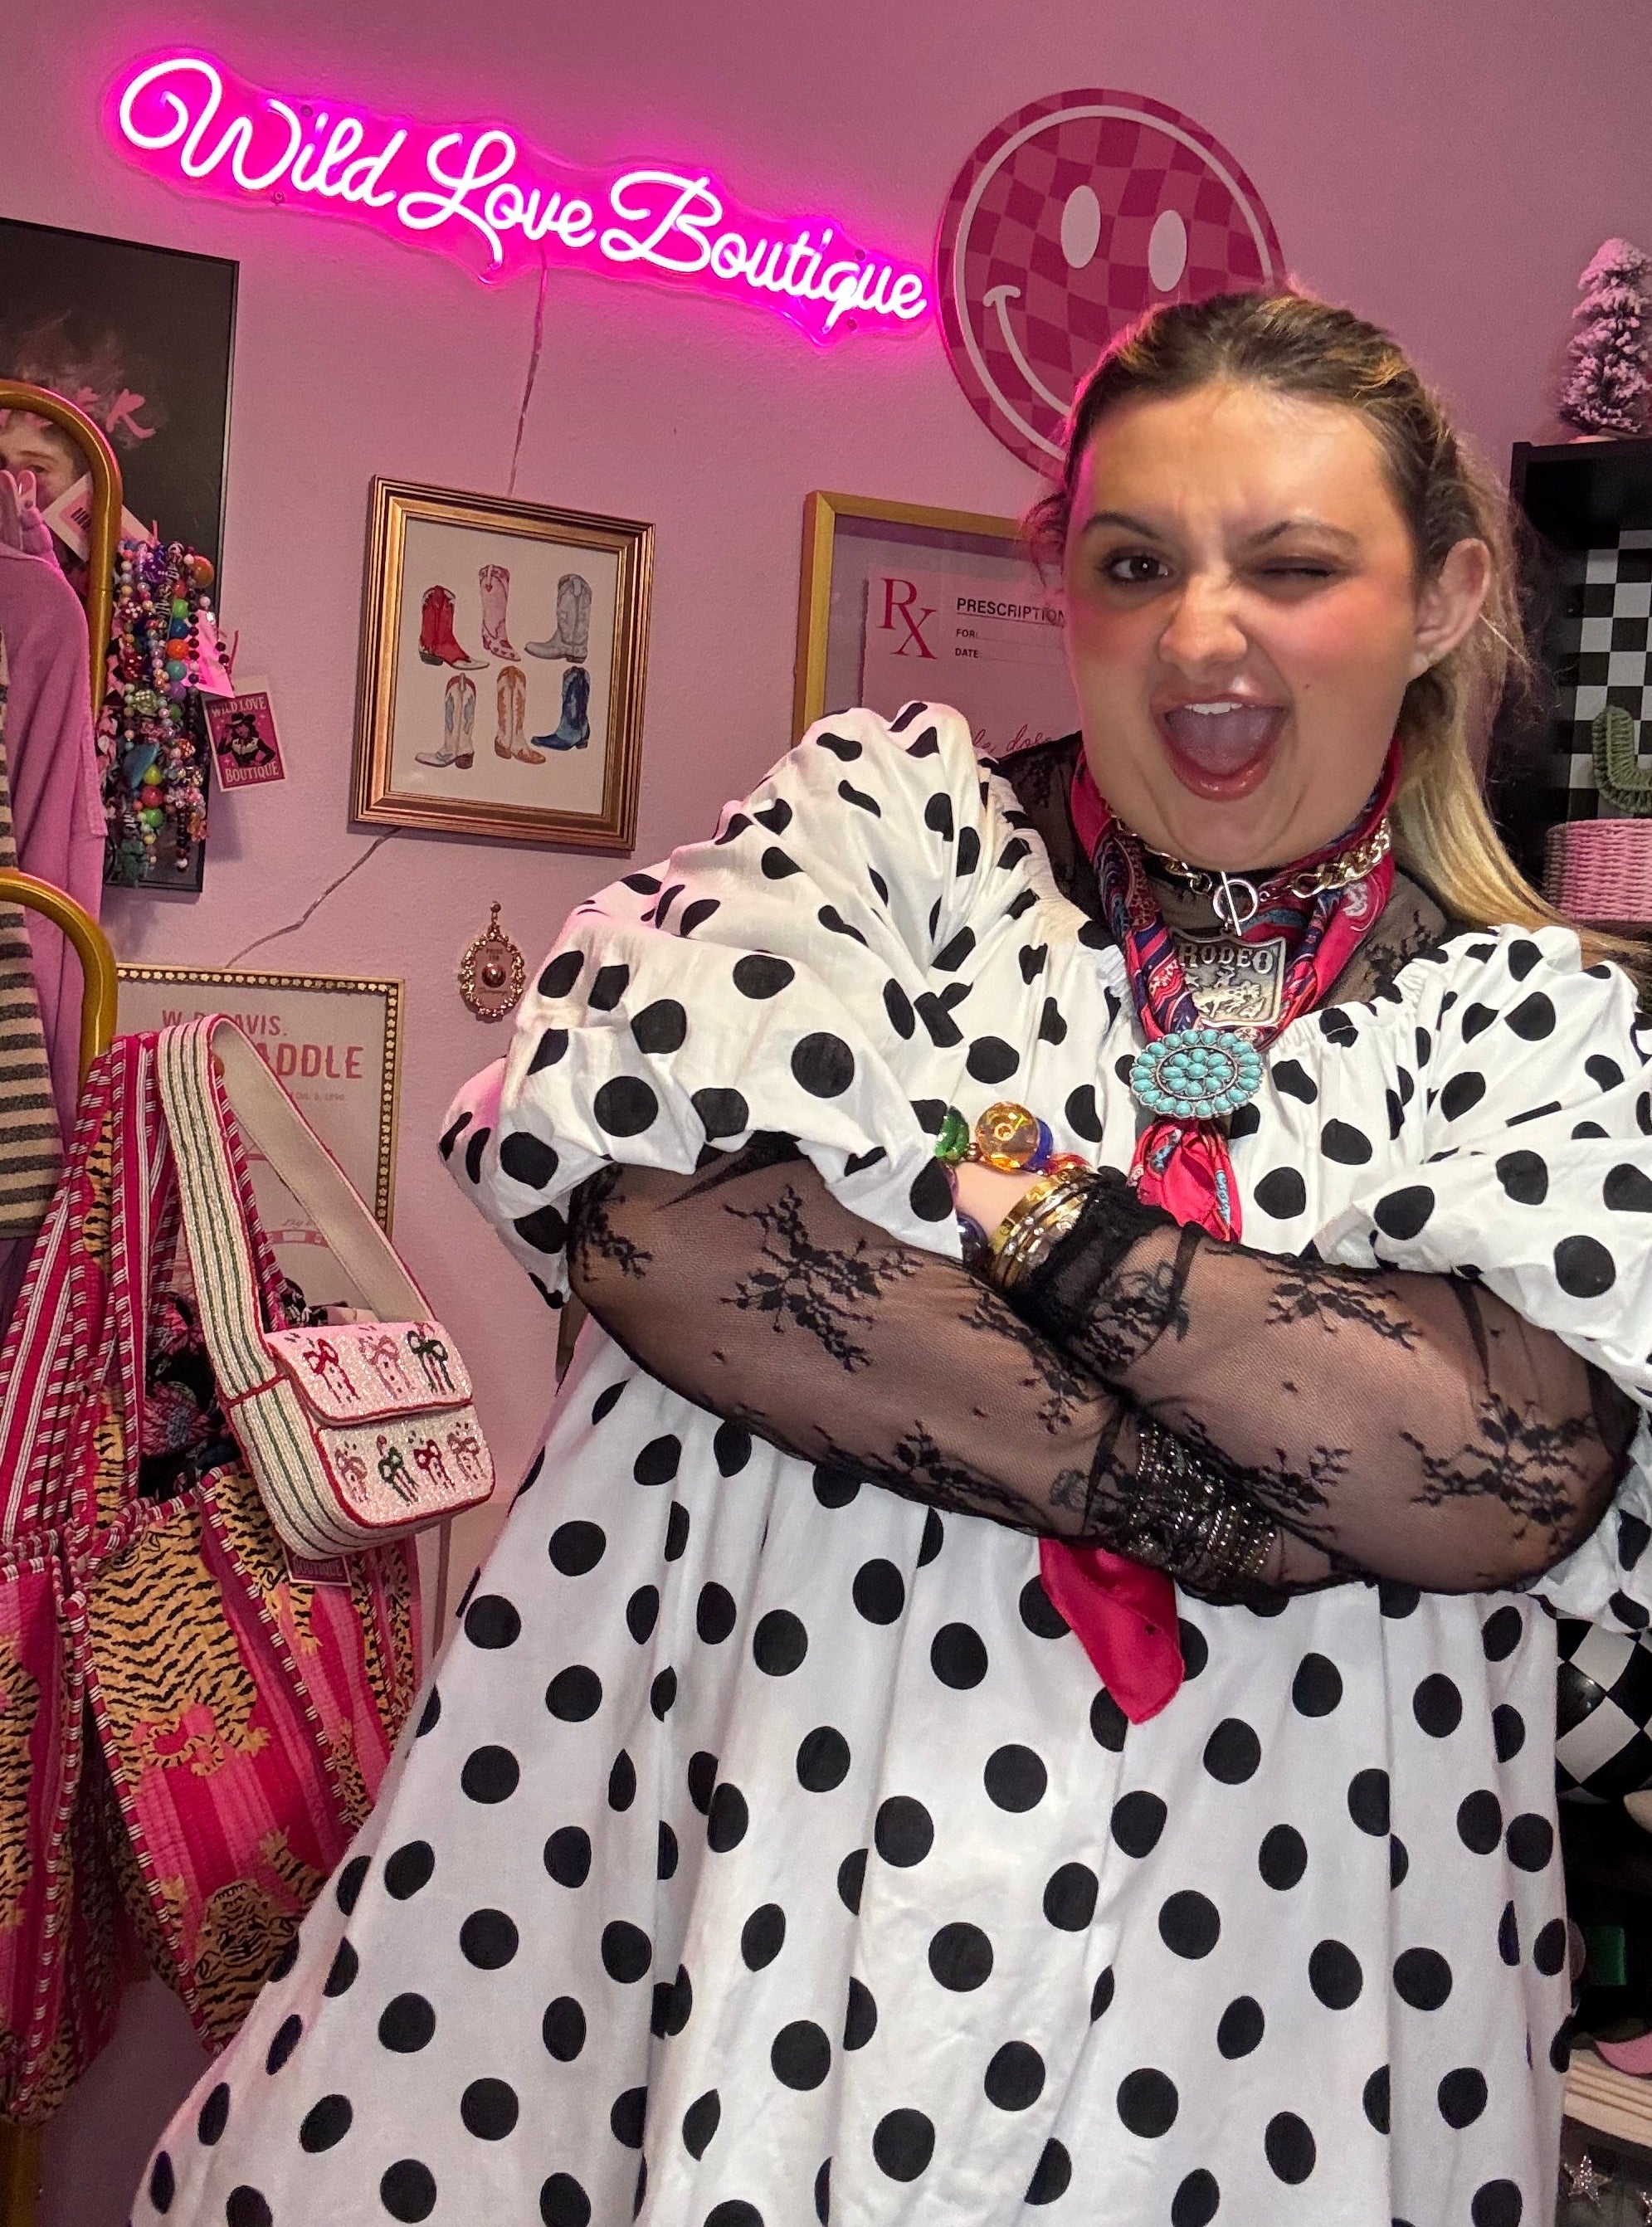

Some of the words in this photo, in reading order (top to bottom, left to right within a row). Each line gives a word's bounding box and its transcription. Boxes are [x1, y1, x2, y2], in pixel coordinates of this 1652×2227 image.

[119, 57, 408, 207] Wild
[397, 129, 597, 267] Love
[599, 170, 928, 335] Boutique
[212, 700, 237, 718] WILD
[241, 696, 266, 711] LOVE
[225, 762, 279, 783] BOUTIQUE
[1178, 943, 1274, 974] RODEO
